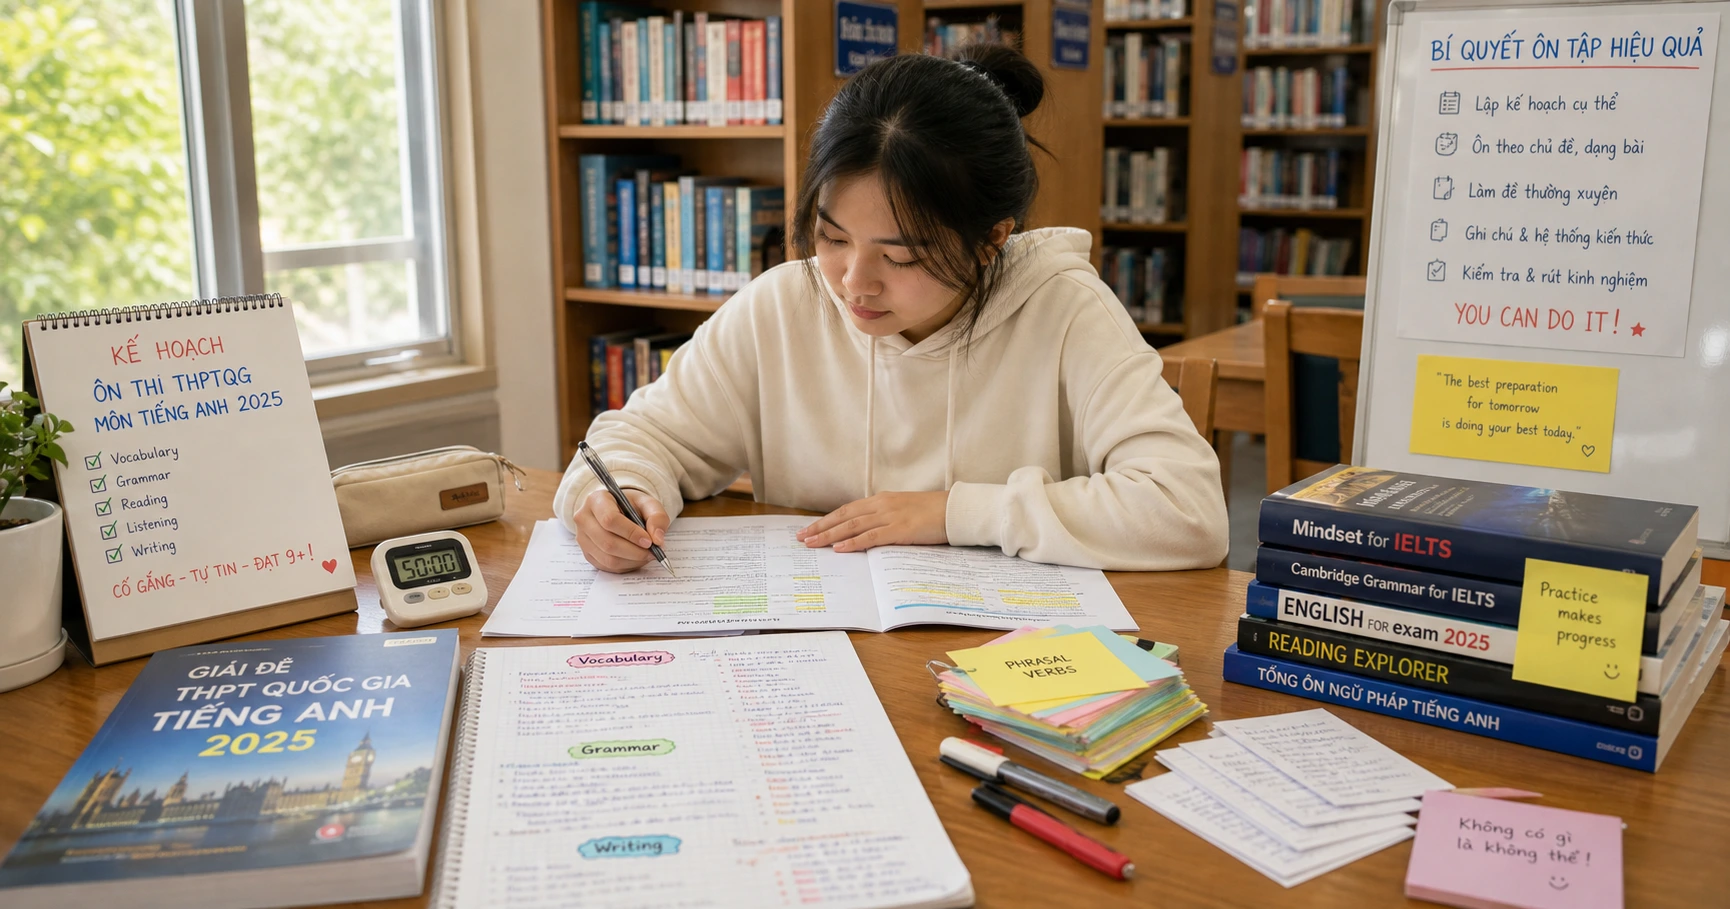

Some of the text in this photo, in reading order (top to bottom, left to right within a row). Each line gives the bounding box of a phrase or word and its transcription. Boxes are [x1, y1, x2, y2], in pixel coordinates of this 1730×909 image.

[1431, 27, 1703, 63] BÍ QUYẾT ÔN TẬP HIỆU QUẢ
[1476, 91, 1619, 117] Lập kế hoạch cụ thể
[1472, 134, 1644, 161] Ôn theo chủ đề, dạng bài
[1469, 182, 1495, 198] Làm
[1502, 182, 1518, 199] đề
[1525, 183, 1570, 206] thường
[1465, 225, 1654, 250] Ghi chú & hệ thống kiến thức
[1500, 267, 1520, 282] tra
[1526, 267, 1535, 282] &
[1542, 269, 1561, 284] rút
[1568, 269, 1594, 285] kinh
[1601, 271, 1647, 292] nghiệm
[1455, 303, 1491, 325] YOU
[1500, 306, 1538, 328] CAN
[1548, 308, 1574, 330] DO
[111, 334, 224, 366] KẾ HOẠCH
[94, 378, 122, 402] ÔN
[172, 367, 252, 392] THPTQG
[1468, 375, 1490, 388] best
[1495, 381, 1558, 395] preparation
[94, 390, 283, 433] MÔN TIẾNG ANH 2025
[1467, 395, 1540, 413] for tomorrow
[1442, 417, 1450, 429] is
[1455, 417, 1483, 437] doing
[1488, 425, 1511, 437] your
[1516, 422, 1538, 435] best
[110, 446, 179, 465] Vocabulary
[116, 472, 170, 487] Grammar
[121, 495, 168, 510] Reading
[126, 517, 178, 533] Listening
[131, 542, 176, 557] Writing
[1293, 519, 1451, 558] Mindset for IELTS
[113, 576, 131, 598] CỐ
[137, 570, 175, 593] GẮNG
[189, 565, 208, 584] TỰ
[213, 562, 237, 577] TIN
[253, 553, 279, 571] ĐẠT
[402, 553, 456, 580] 50:00
[1291, 562, 1495, 608] Cambridge Grammar for IELTS
[1541, 581, 1598, 604] Practice
[1284, 597, 1363, 628] ENGLISH
[1368, 619, 1389, 633] FOR
[1393, 623, 1438, 642] exam
[1444, 628, 1490, 651] 2025
[1558, 609, 1602, 625] makes
[1557, 631, 1616, 650] progress
[579, 654, 662, 664] Vocabulary
[1005, 655, 1071, 669] PHRASAL
[1267, 631, 1347, 664] READING
[1354, 648, 1449, 684] EXPLORER
[1023, 666, 1077, 678] VERBS
[177, 673, 411, 701] THPT QUỐC GIA
[153, 697, 394, 731] TIẾNG ANH
[1302, 674, 1324, 693] ÔN
[1367, 690, 1408, 710] PHÁP
[1412, 699, 1459, 722] TIẾNG
[1464, 711, 1500, 730] ANH
[199, 729, 317, 756] 2025
[581, 744, 659, 754] Grammar
[1459, 817, 1571, 847] Không có gì
[594, 841, 663, 855] Writing
[1457, 837, 1473, 850] là
[1485, 841, 1537, 864] không
